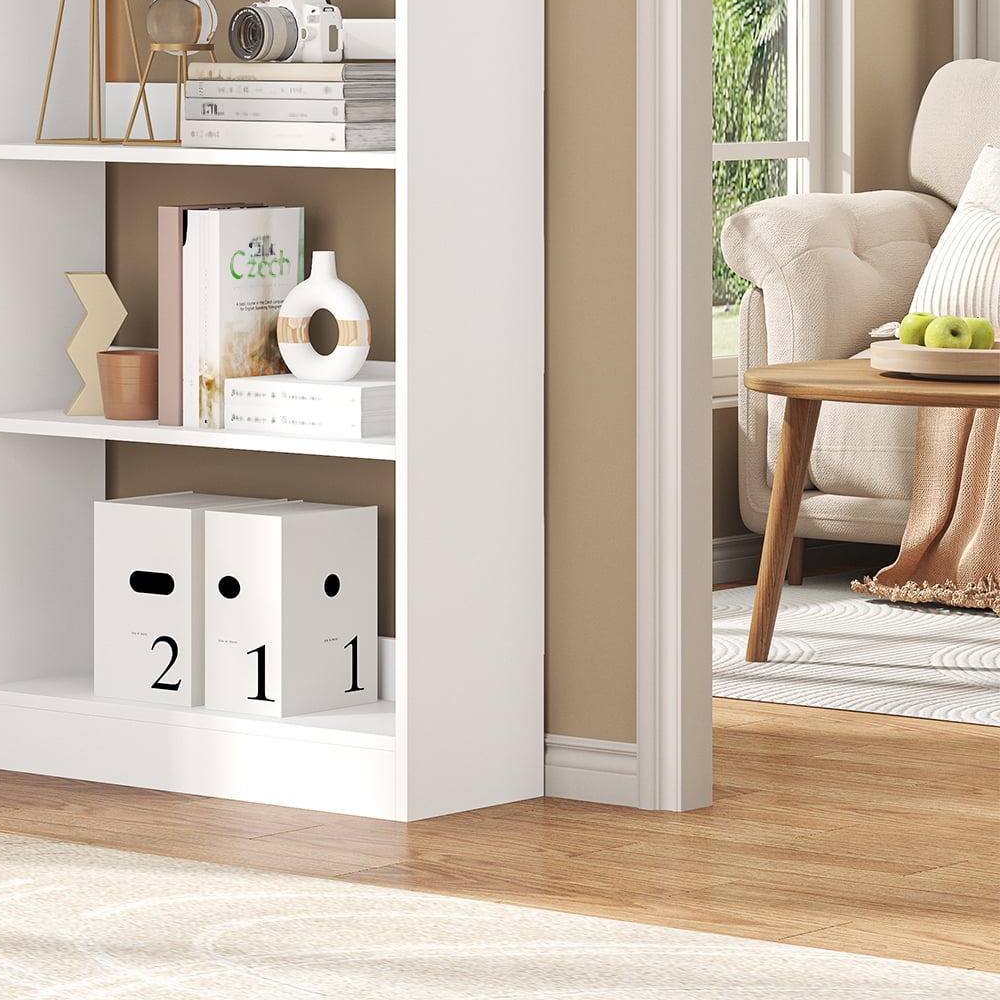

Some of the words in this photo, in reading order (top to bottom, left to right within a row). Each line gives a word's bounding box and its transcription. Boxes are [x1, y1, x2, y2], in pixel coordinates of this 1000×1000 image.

[229, 249, 291, 280] Czech
[151, 635, 182, 692] 2
[246, 644, 276, 703] 1
[343, 635, 365, 693] 1
